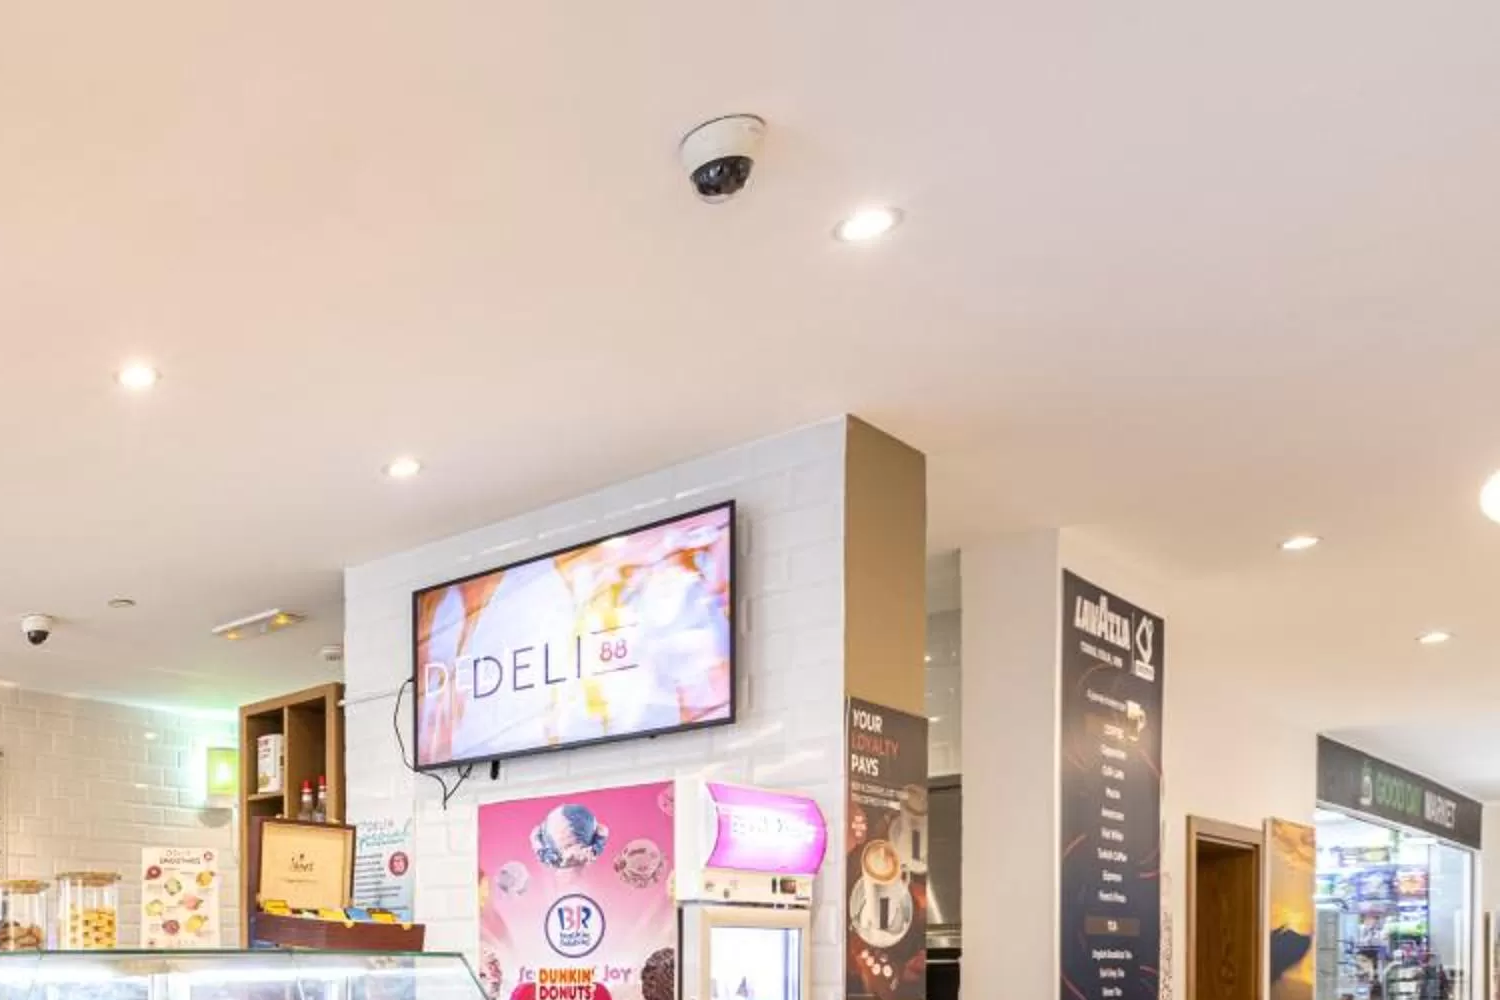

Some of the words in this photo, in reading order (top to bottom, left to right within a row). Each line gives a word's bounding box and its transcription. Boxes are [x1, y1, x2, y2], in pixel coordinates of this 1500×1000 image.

[473, 635, 581, 699] DELI
[600, 638, 628, 662] 88
[852, 708, 883, 733] YOUR
[851, 754, 879, 777] PAYS
[539, 968, 595, 984] DUNKIN'
[539, 985, 592, 1000] DONUTS
